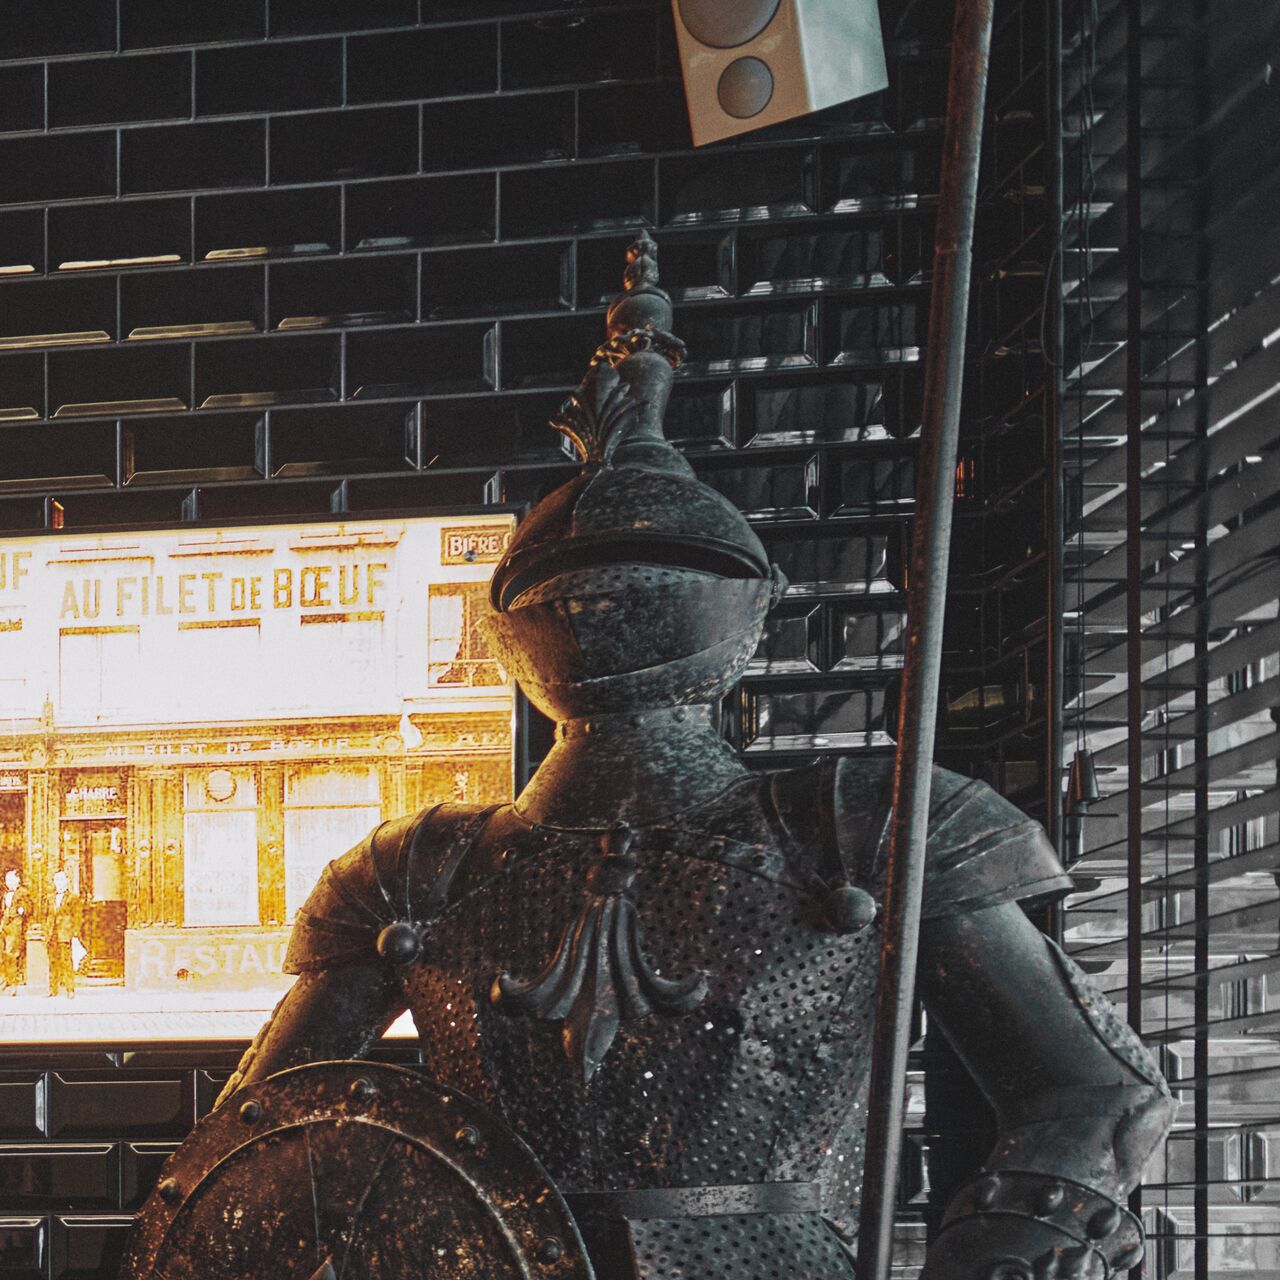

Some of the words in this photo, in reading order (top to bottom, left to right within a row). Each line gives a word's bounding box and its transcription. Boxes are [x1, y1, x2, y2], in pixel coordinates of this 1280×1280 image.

[59, 579, 101, 619] AU
[117, 572, 223, 617] FILET
[230, 576, 262, 611] DE
[136, 940, 289, 988] RESTAU
